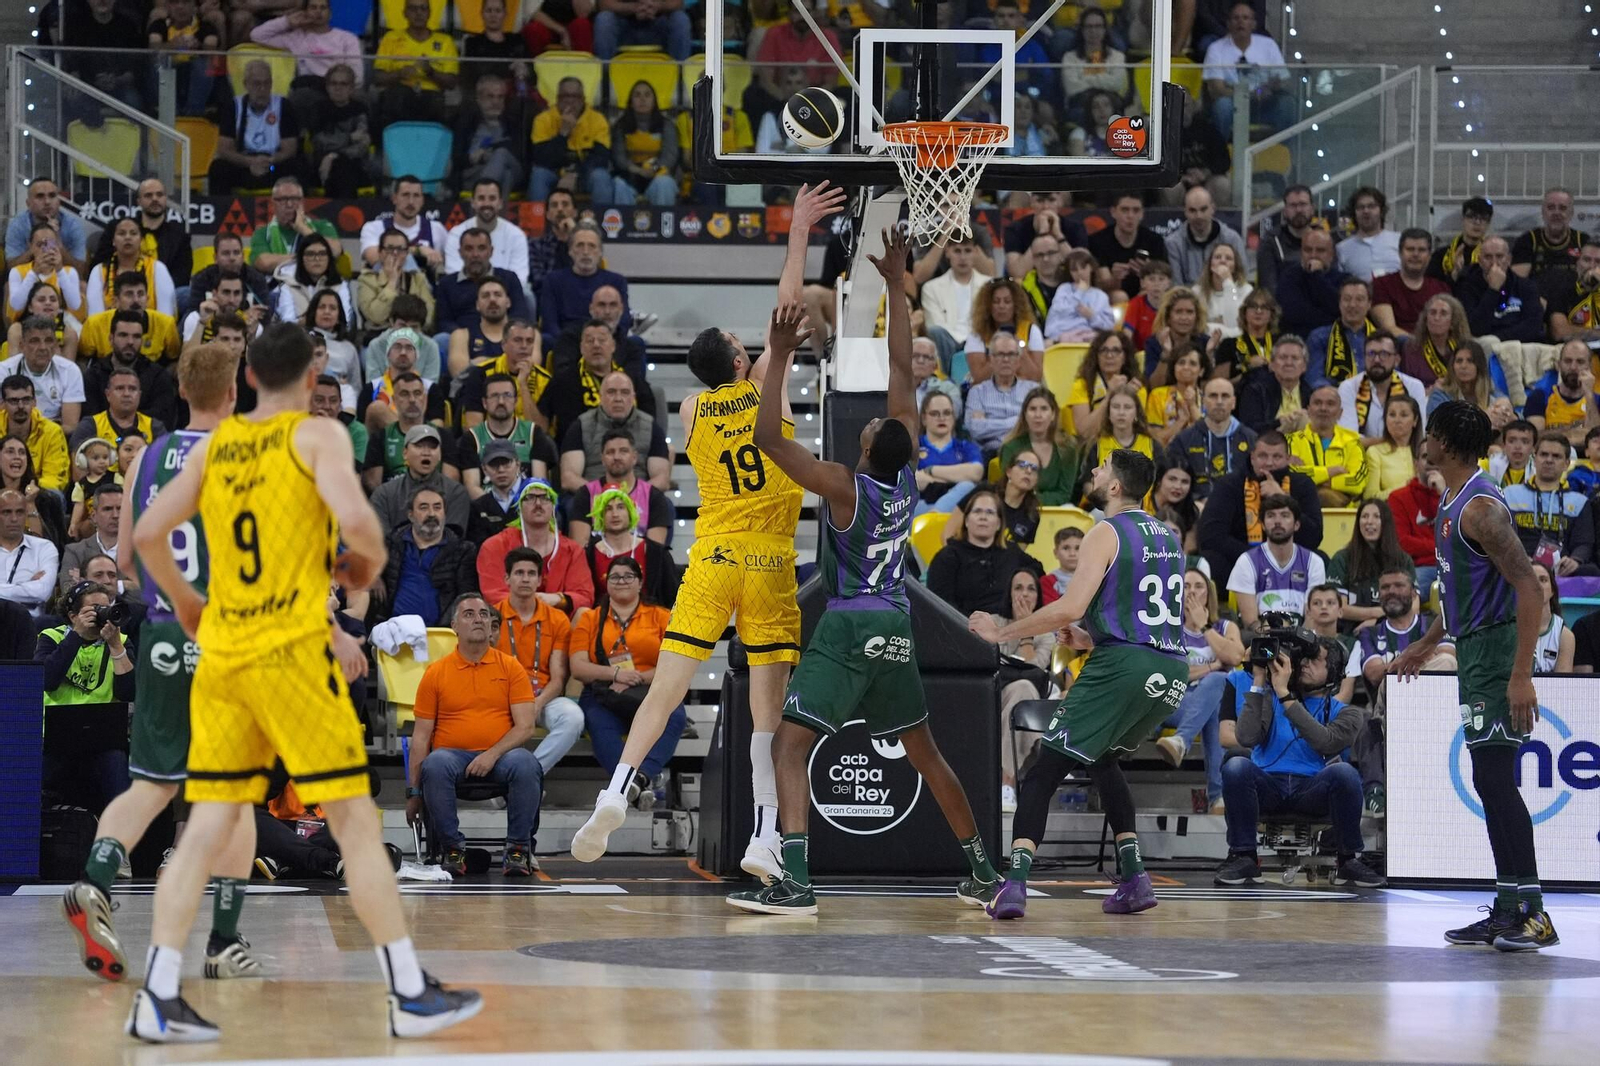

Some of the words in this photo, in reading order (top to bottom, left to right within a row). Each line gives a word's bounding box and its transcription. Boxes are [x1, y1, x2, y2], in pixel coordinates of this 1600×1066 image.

[1112, 132, 1133, 140] Copa
[719, 443, 766, 495] 19
[883, 496, 911, 517] Sima
[1138, 521, 1169, 536] Tillie
[168, 521, 199, 582] 9
[233, 510, 262, 584] 9
[744, 554, 783, 568] CICAR
[866, 530, 909, 586] 77
[1137, 573, 1184, 626] 33
[885, 645, 897, 653] DEL
[840, 753, 869, 766] acb
[828, 764, 883, 785] Copa
[832, 783, 852, 795] del
[854, 785, 891, 805] Rey
[823, 806, 845, 815] Gran
[846, 806, 880, 815] Canaria
